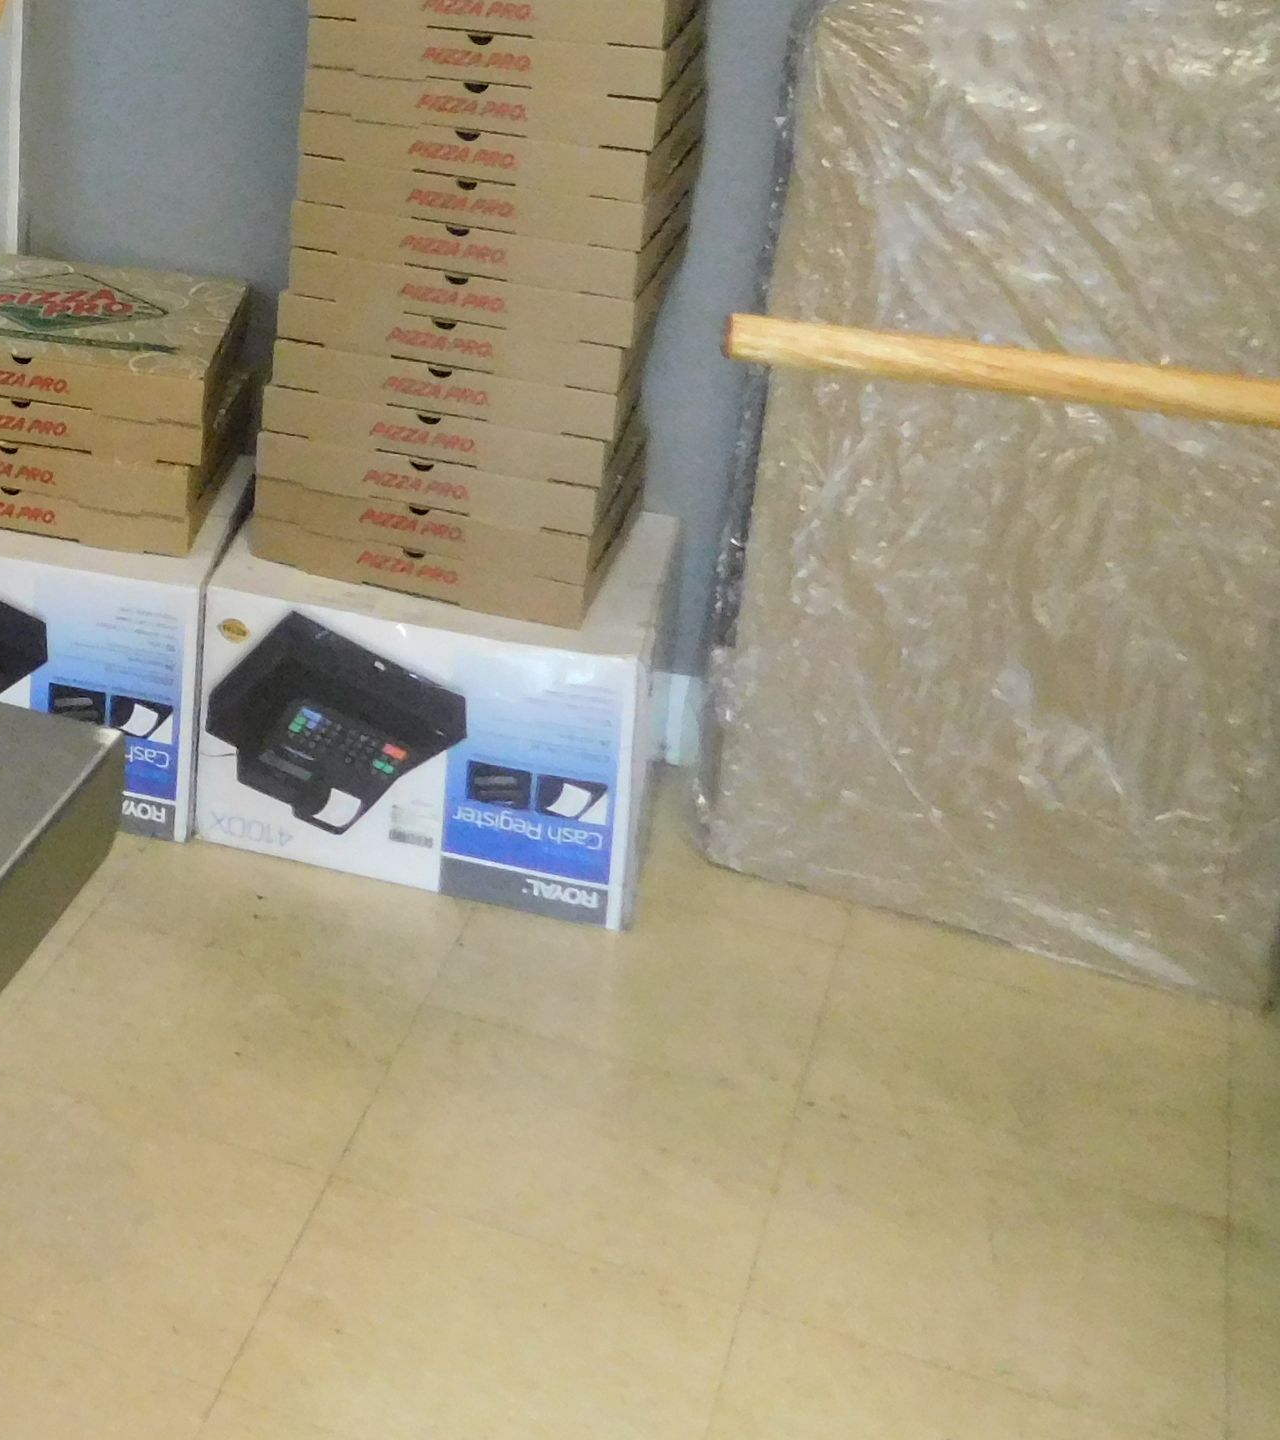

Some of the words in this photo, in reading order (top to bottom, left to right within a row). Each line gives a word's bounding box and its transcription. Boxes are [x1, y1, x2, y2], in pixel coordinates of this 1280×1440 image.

[421, 47, 483, 67] PIZZA
[416, 94, 478, 114] PIZZA
[408, 140, 470, 162] PIZZA
[406, 188, 468, 210] PIZZA
[399, 234, 461, 256] PIZZA
[399, 283, 459, 304] PIZZA
[41, 300, 134, 318] PRO
[386, 326, 447, 350] PIZZA
[382, 375, 445, 398] PIZZA
[369, 421, 430, 445] PIZZA
[362, 469, 422, 491] PIZZA
[359, 508, 418, 532] PIZZA
[356, 549, 416, 576] PIZZA
[451, 806, 542, 841] Register
[547, 825, 604, 851] Cash
